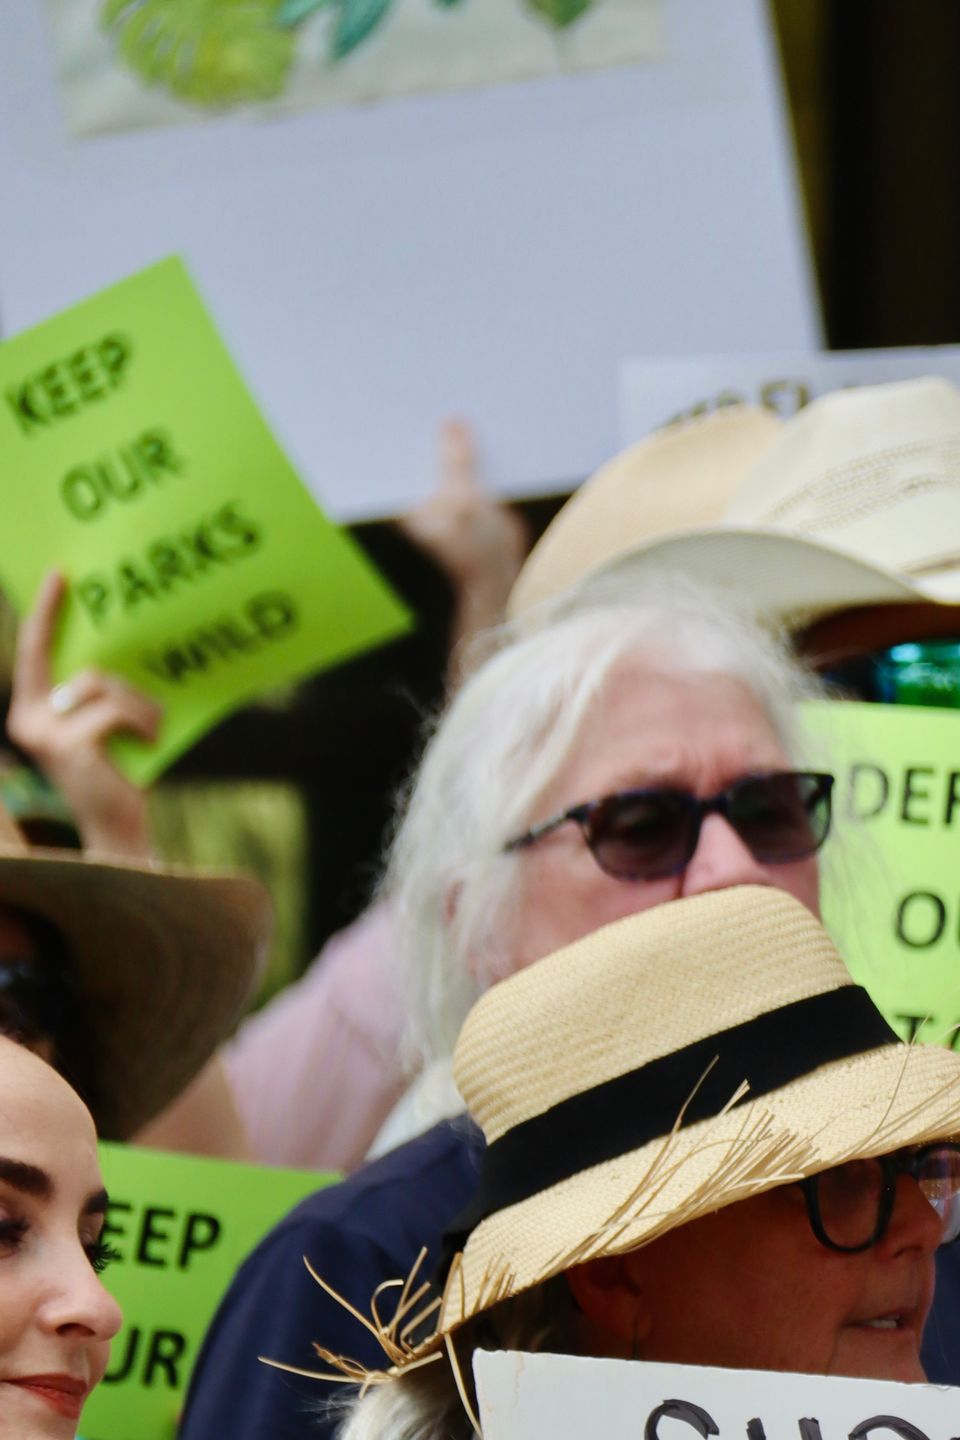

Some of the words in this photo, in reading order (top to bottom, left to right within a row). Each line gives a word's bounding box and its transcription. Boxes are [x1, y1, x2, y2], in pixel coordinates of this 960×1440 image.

[8, 332, 132, 436] KEEP
[60, 427, 184, 522] OUR
[76, 503, 260, 627] PARKS
[142, 592, 298, 686] WILD
[100, 1200, 222, 1272] EEP
[102, 1325, 187, 1389] UR
